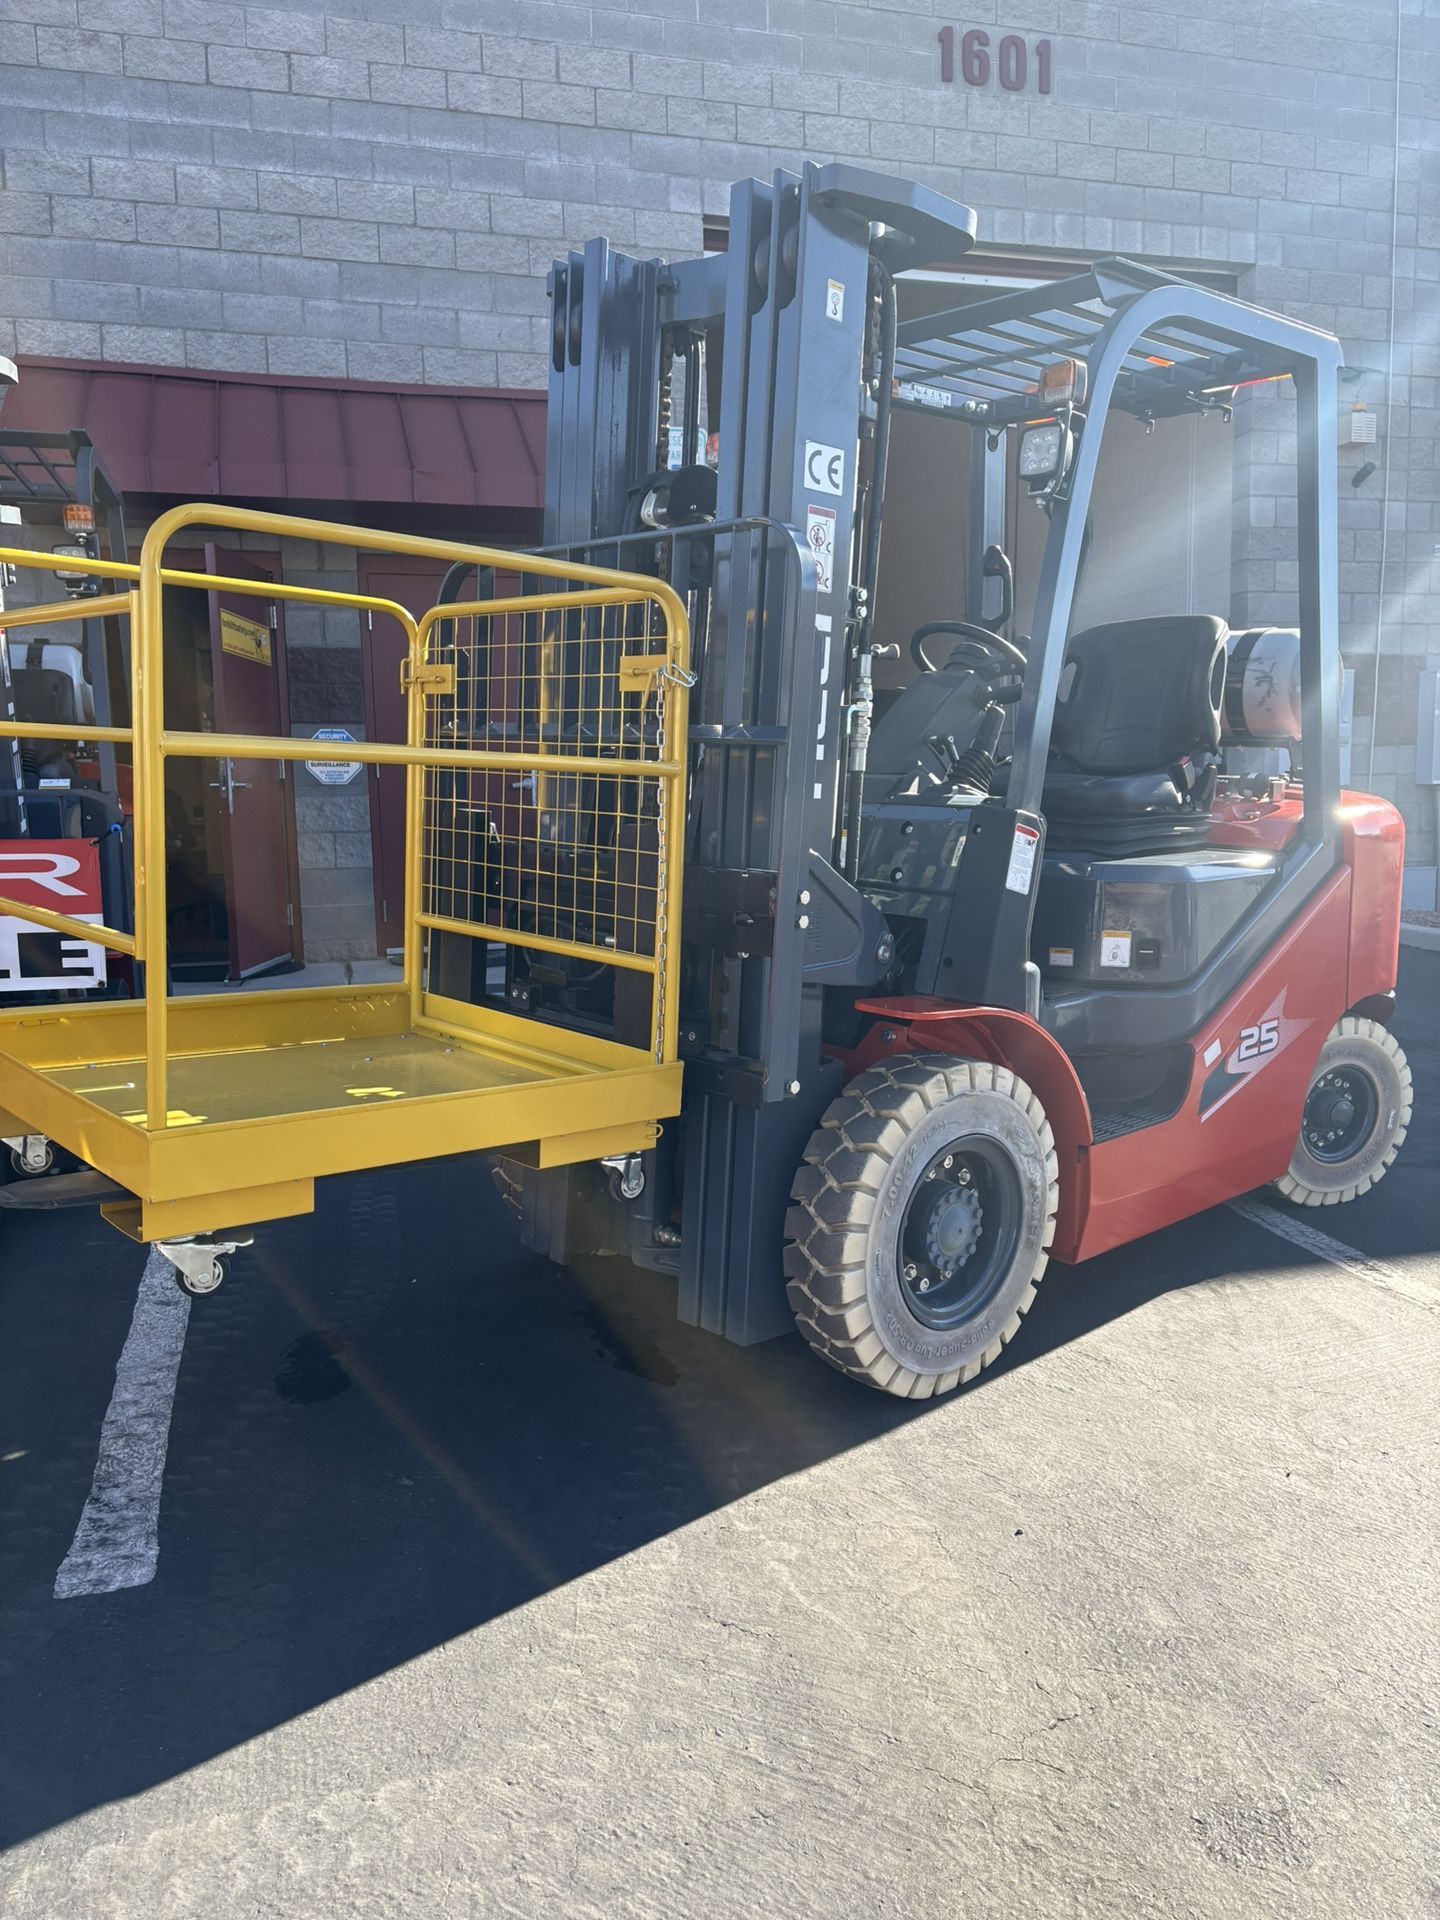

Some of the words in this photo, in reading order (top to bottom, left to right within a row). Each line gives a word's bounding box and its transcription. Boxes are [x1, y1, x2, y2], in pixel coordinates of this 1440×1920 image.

[938, 26, 1051, 95] 1601
[808, 449, 841, 490] CE
[1238, 1017, 1279, 1062] 25
